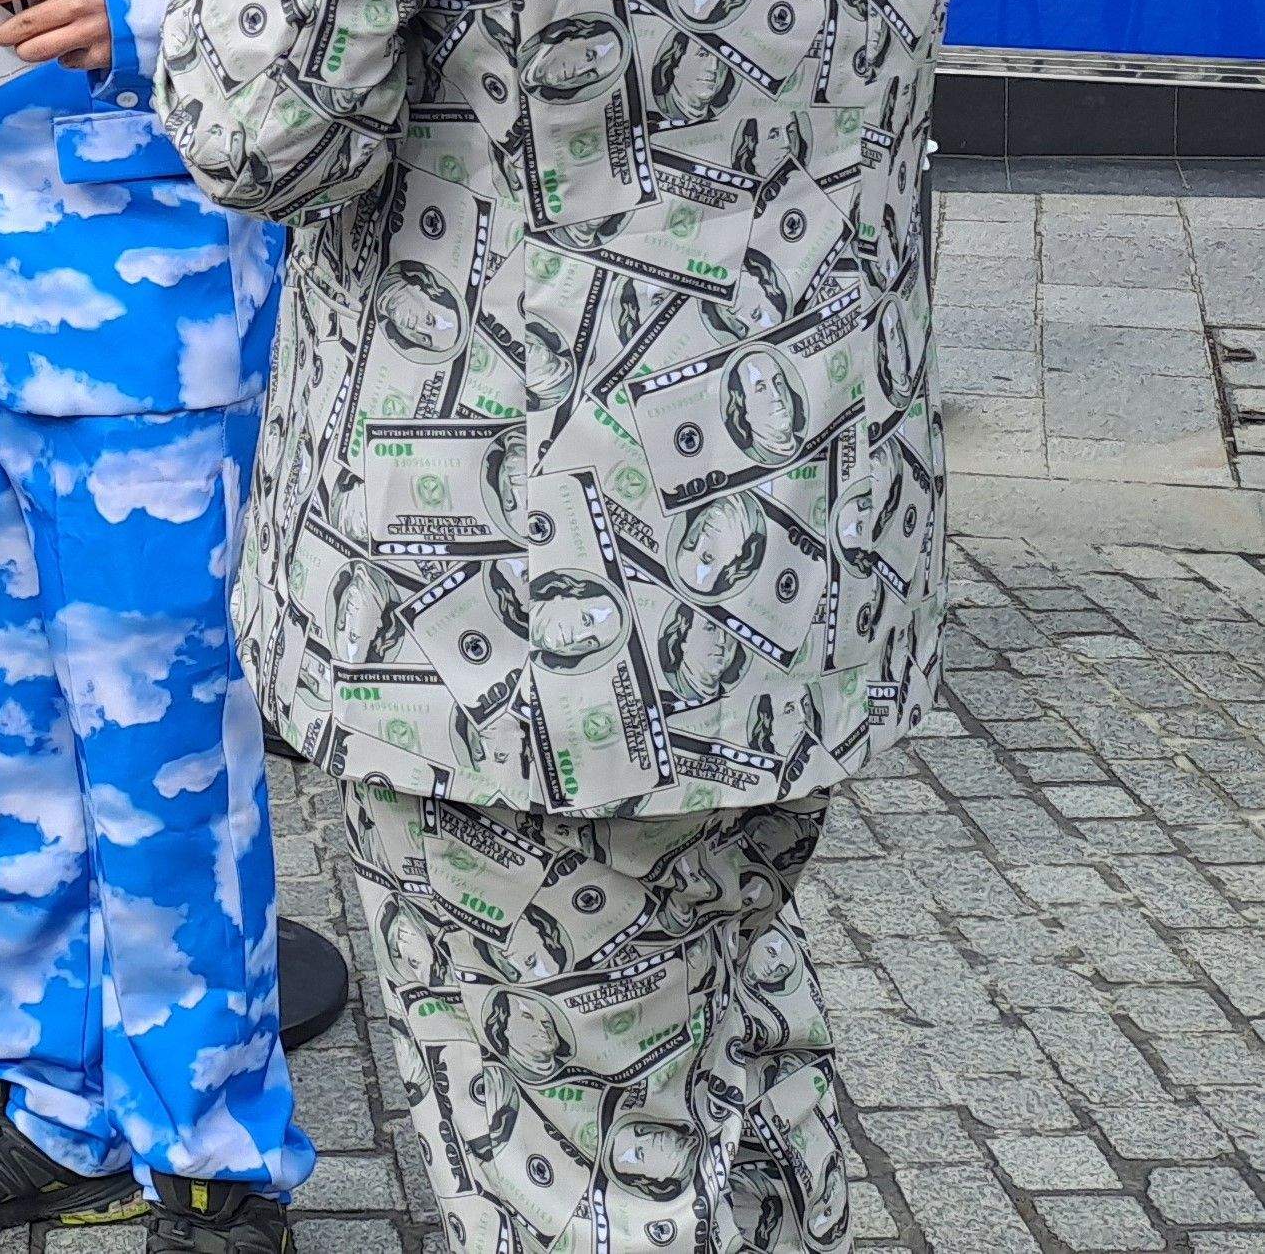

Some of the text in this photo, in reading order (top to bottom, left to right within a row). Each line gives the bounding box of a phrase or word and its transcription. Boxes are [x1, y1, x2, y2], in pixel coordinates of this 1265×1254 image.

[692, 164, 754, 190] 100
[687, 258, 729, 281] 100
[644, 362, 709, 390] 100
[374, 443, 415, 457] 100
[678, 470, 728, 501] 100
[378, 542, 451, 555] 100
[411, 572, 467, 611] 100
[339, 687, 381, 701] 100
[478, 668, 525, 707] 100
[712, 744, 775, 769] 100
[461, 892, 505, 921] 100
[611, 950, 675, 980] 100
